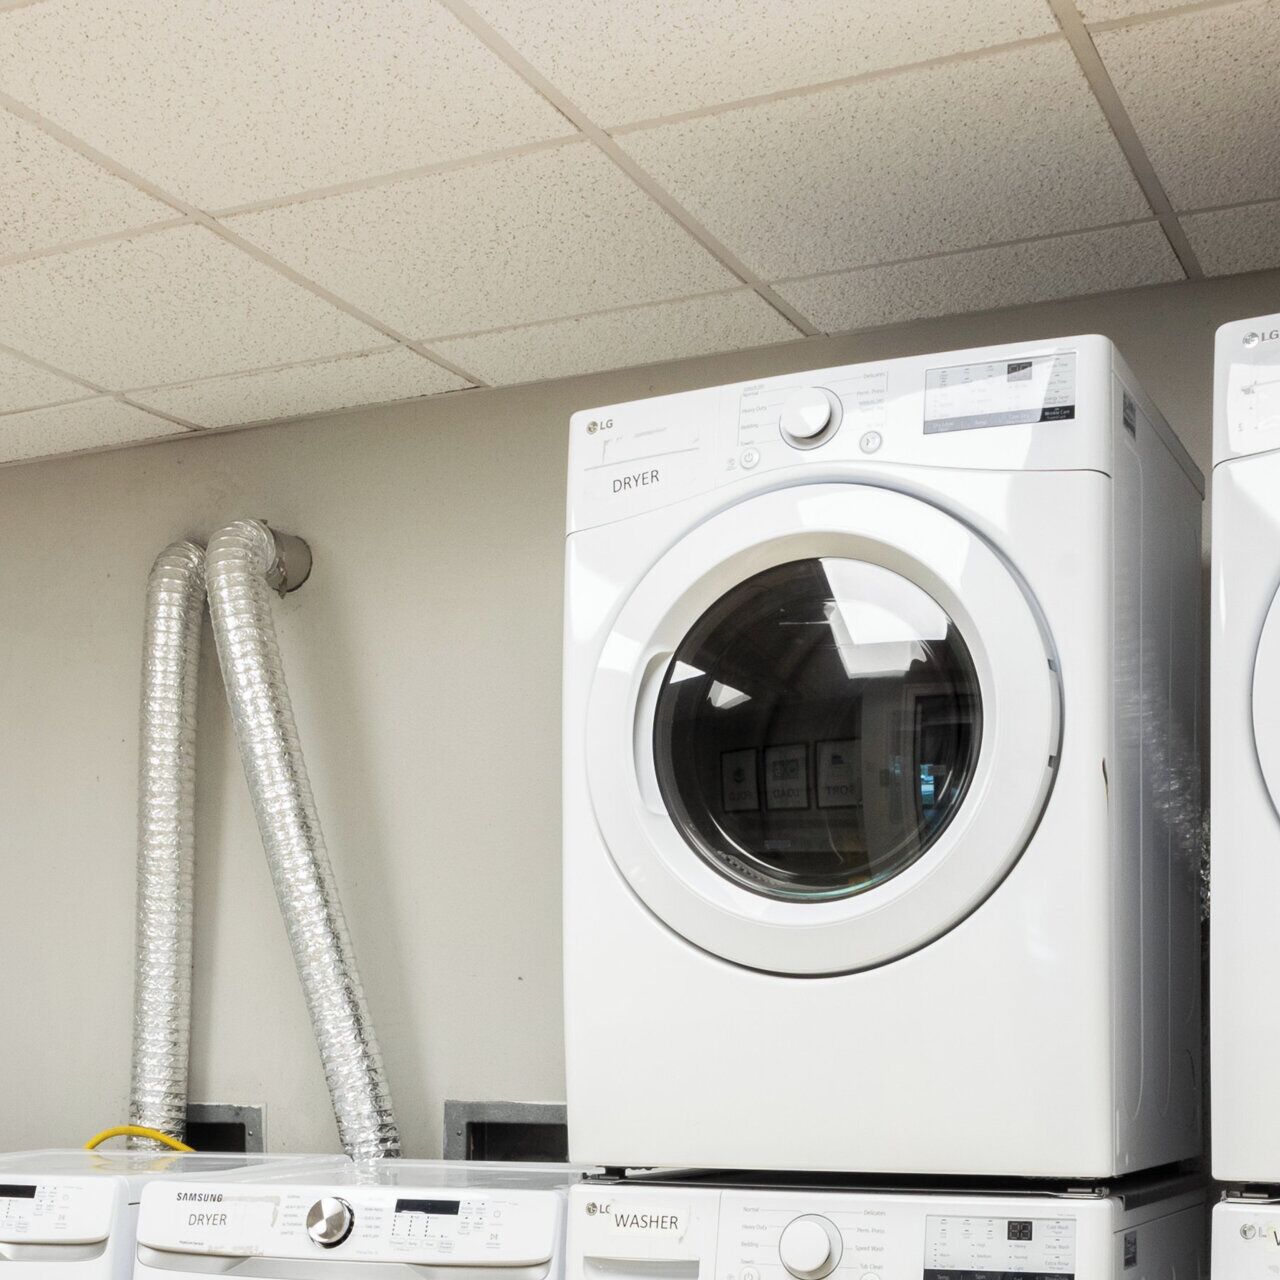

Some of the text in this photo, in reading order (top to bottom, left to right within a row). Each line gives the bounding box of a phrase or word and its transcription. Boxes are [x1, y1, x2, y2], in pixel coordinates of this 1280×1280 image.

[1261, 329, 1279, 342] LG
[600, 419, 614, 430] LG
[612, 469, 660, 493] DRYER
[177, 1192, 223, 1203] SAMSUNG
[188, 1213, 227, 1226] DRYER
[615, 1213, 679, 1230] WASHER
[855, 1245, 870, 1253] Speed
